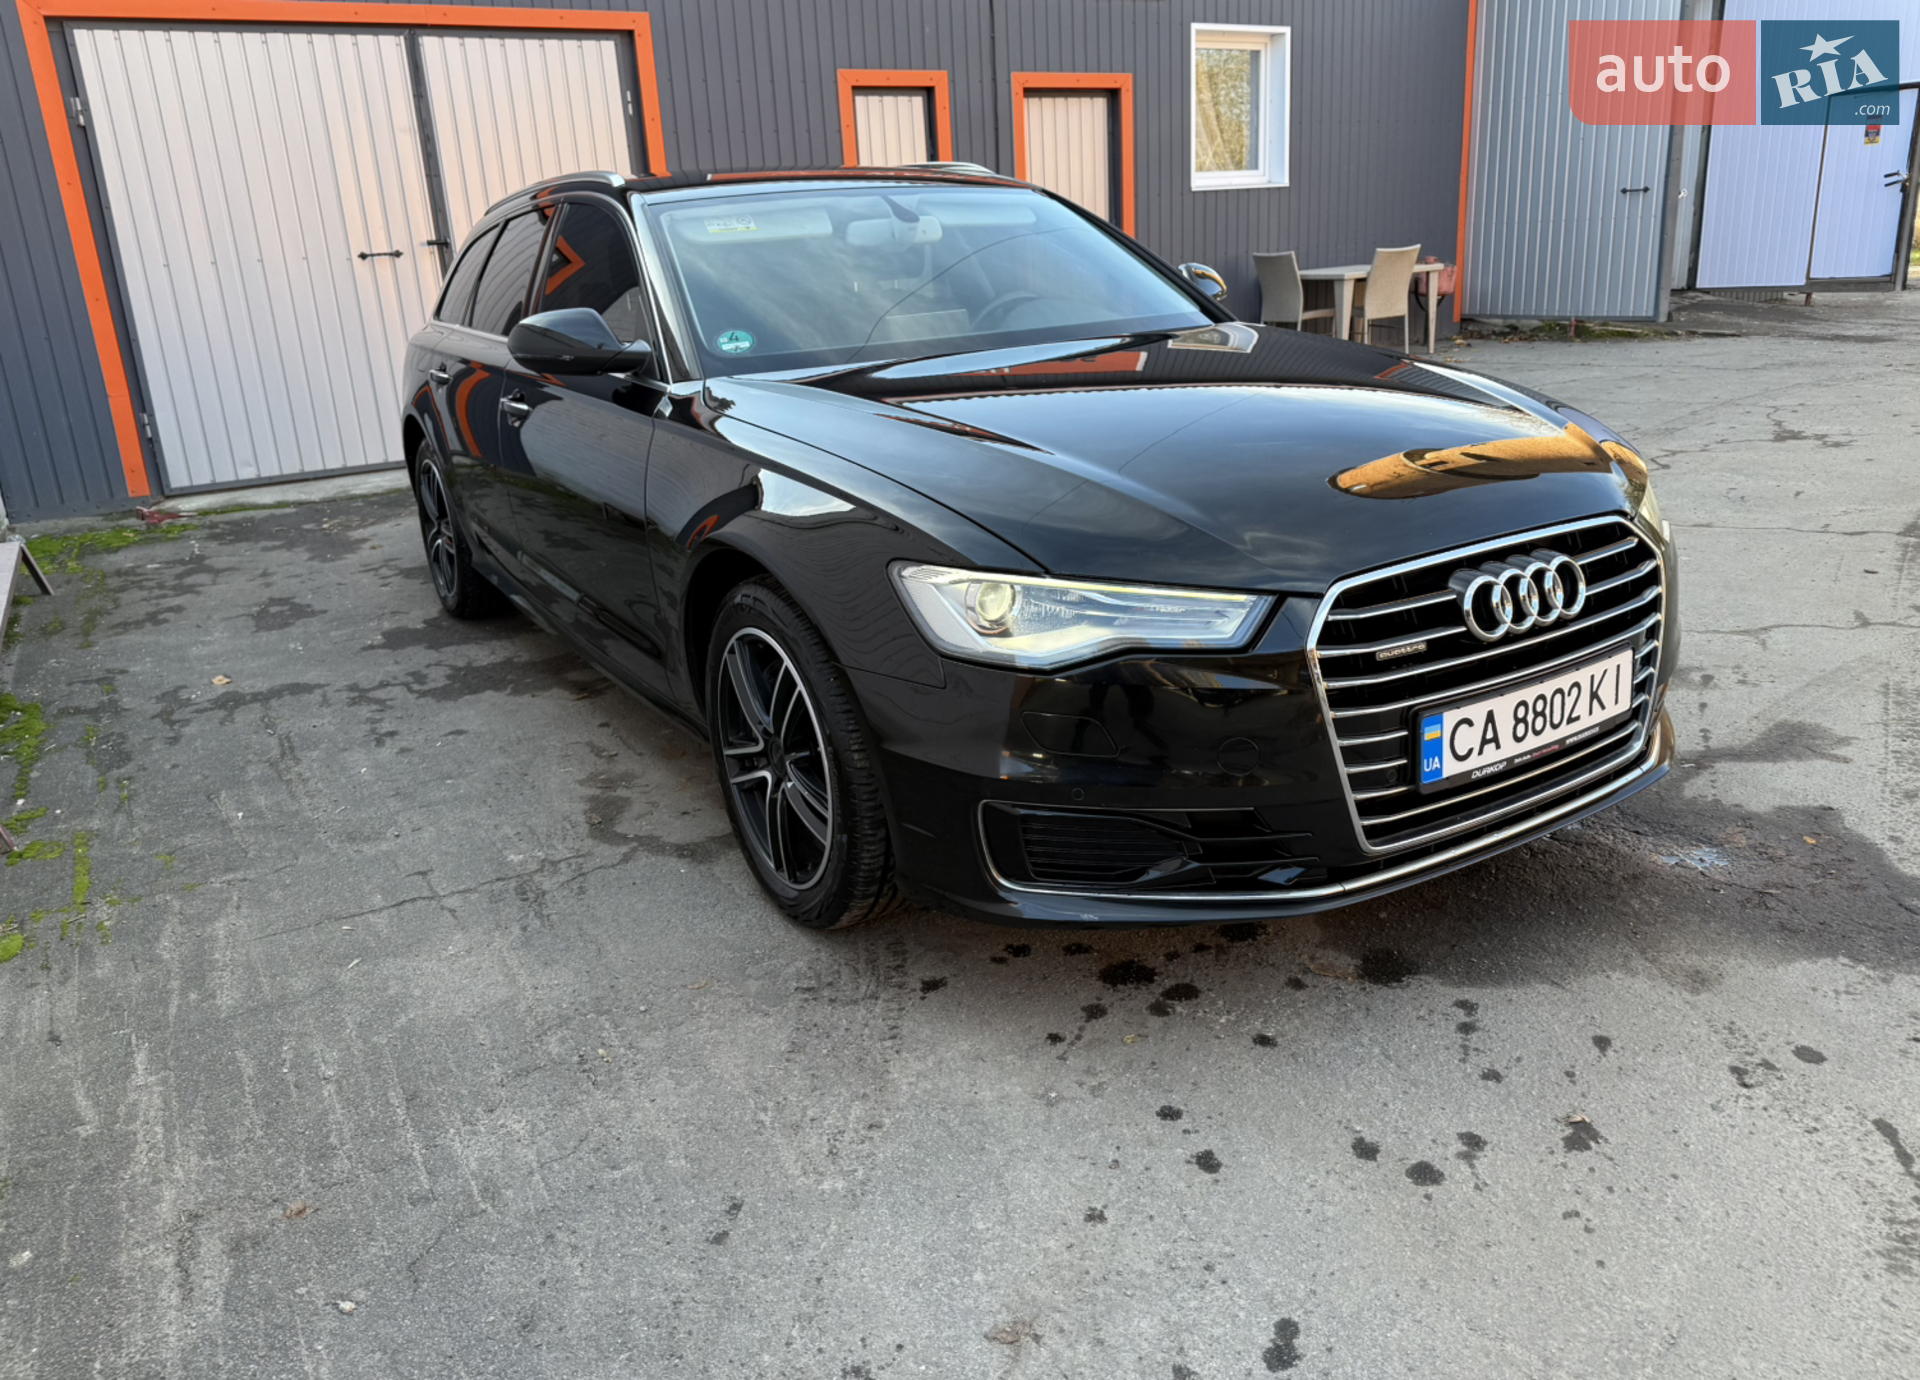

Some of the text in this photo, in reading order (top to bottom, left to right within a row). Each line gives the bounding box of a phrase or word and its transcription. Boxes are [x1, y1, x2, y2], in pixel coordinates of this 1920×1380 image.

[1449, 708, 1501, 762] CA
[1511, 680, 1582, 744] 8802
[1423, 755, 1441, 772] UA
